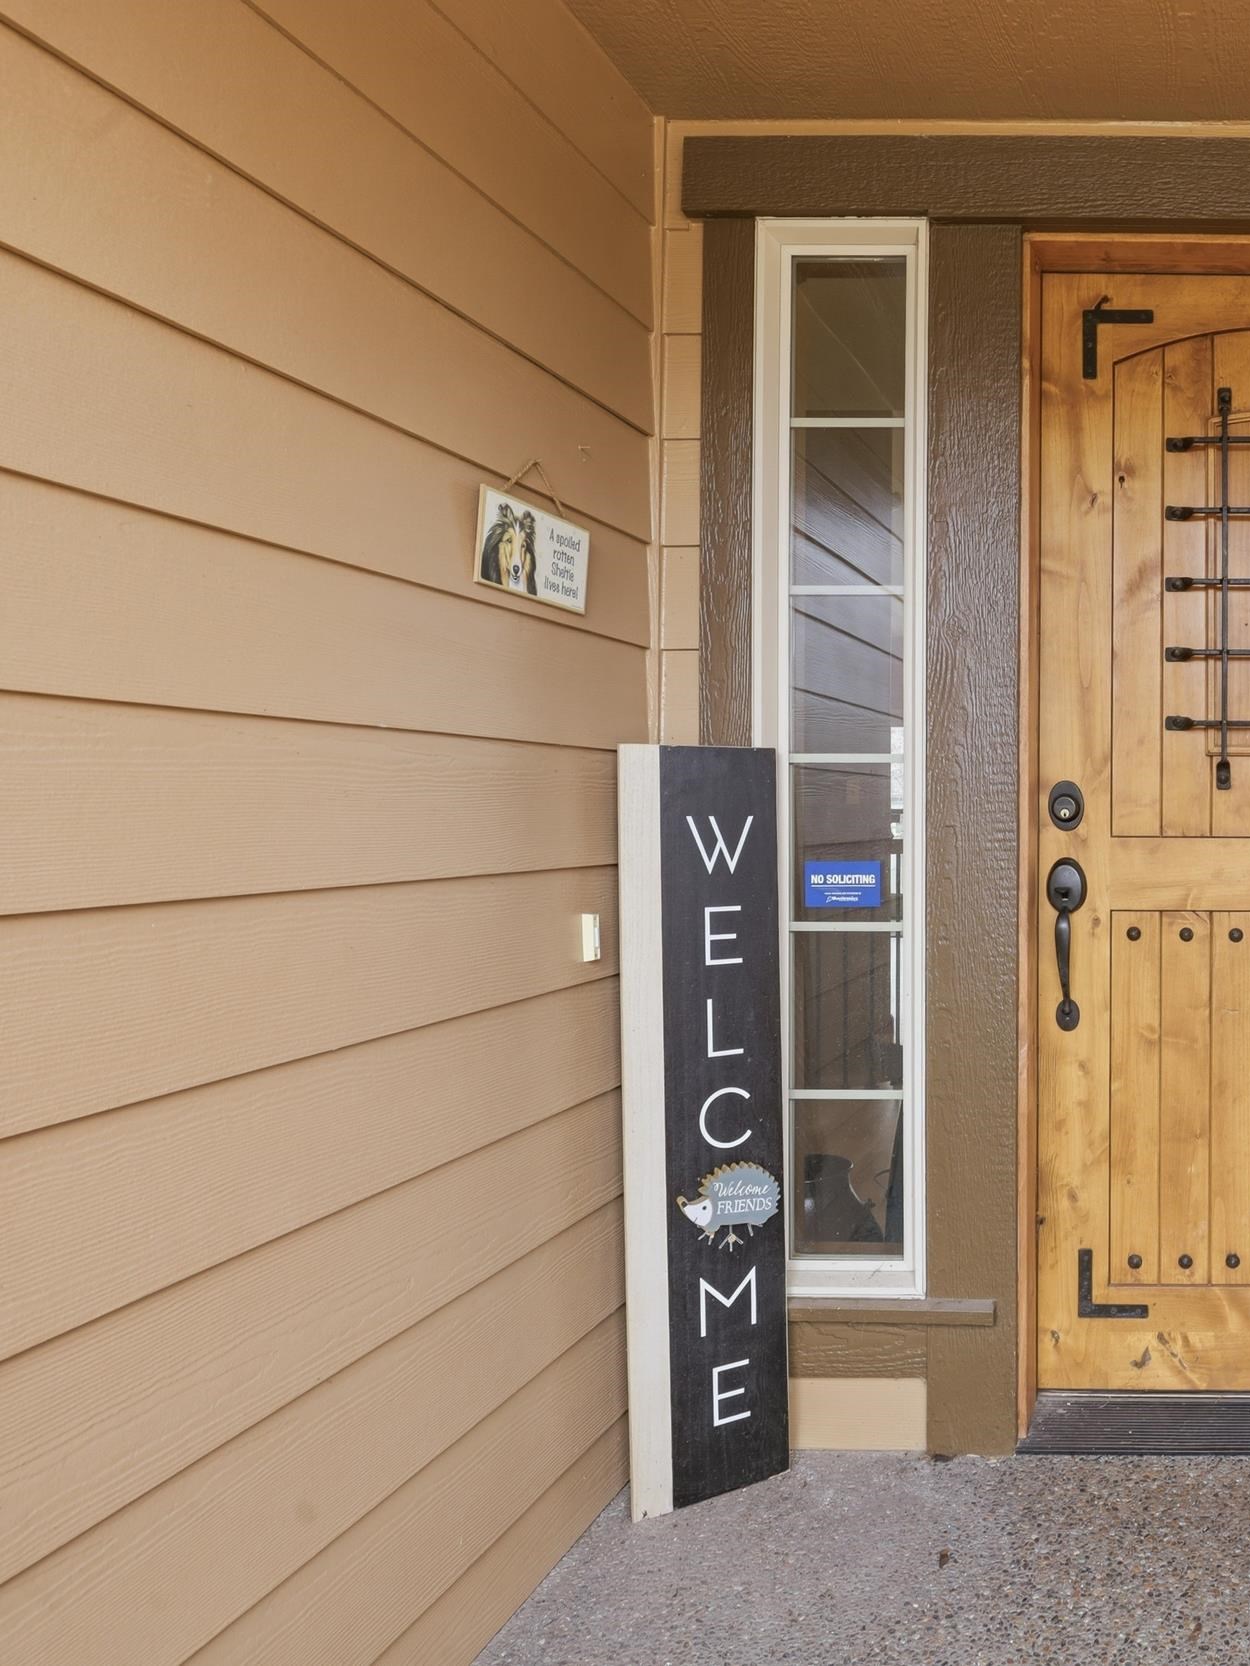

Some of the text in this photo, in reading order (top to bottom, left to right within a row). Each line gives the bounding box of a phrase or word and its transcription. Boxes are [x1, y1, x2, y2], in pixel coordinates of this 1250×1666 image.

[549, 528, 580, 552] A spoiled
[553, 549, 575, 566] rotten
[544, 576, 560, 593] lives
[810, 874, 876, 884] NO SOLICITING
[686, 815, 757, 1427] WELCME
[713, 1180, 770, 1197] Welcome
[717, 1197, 772, 1215] FRIENDS
